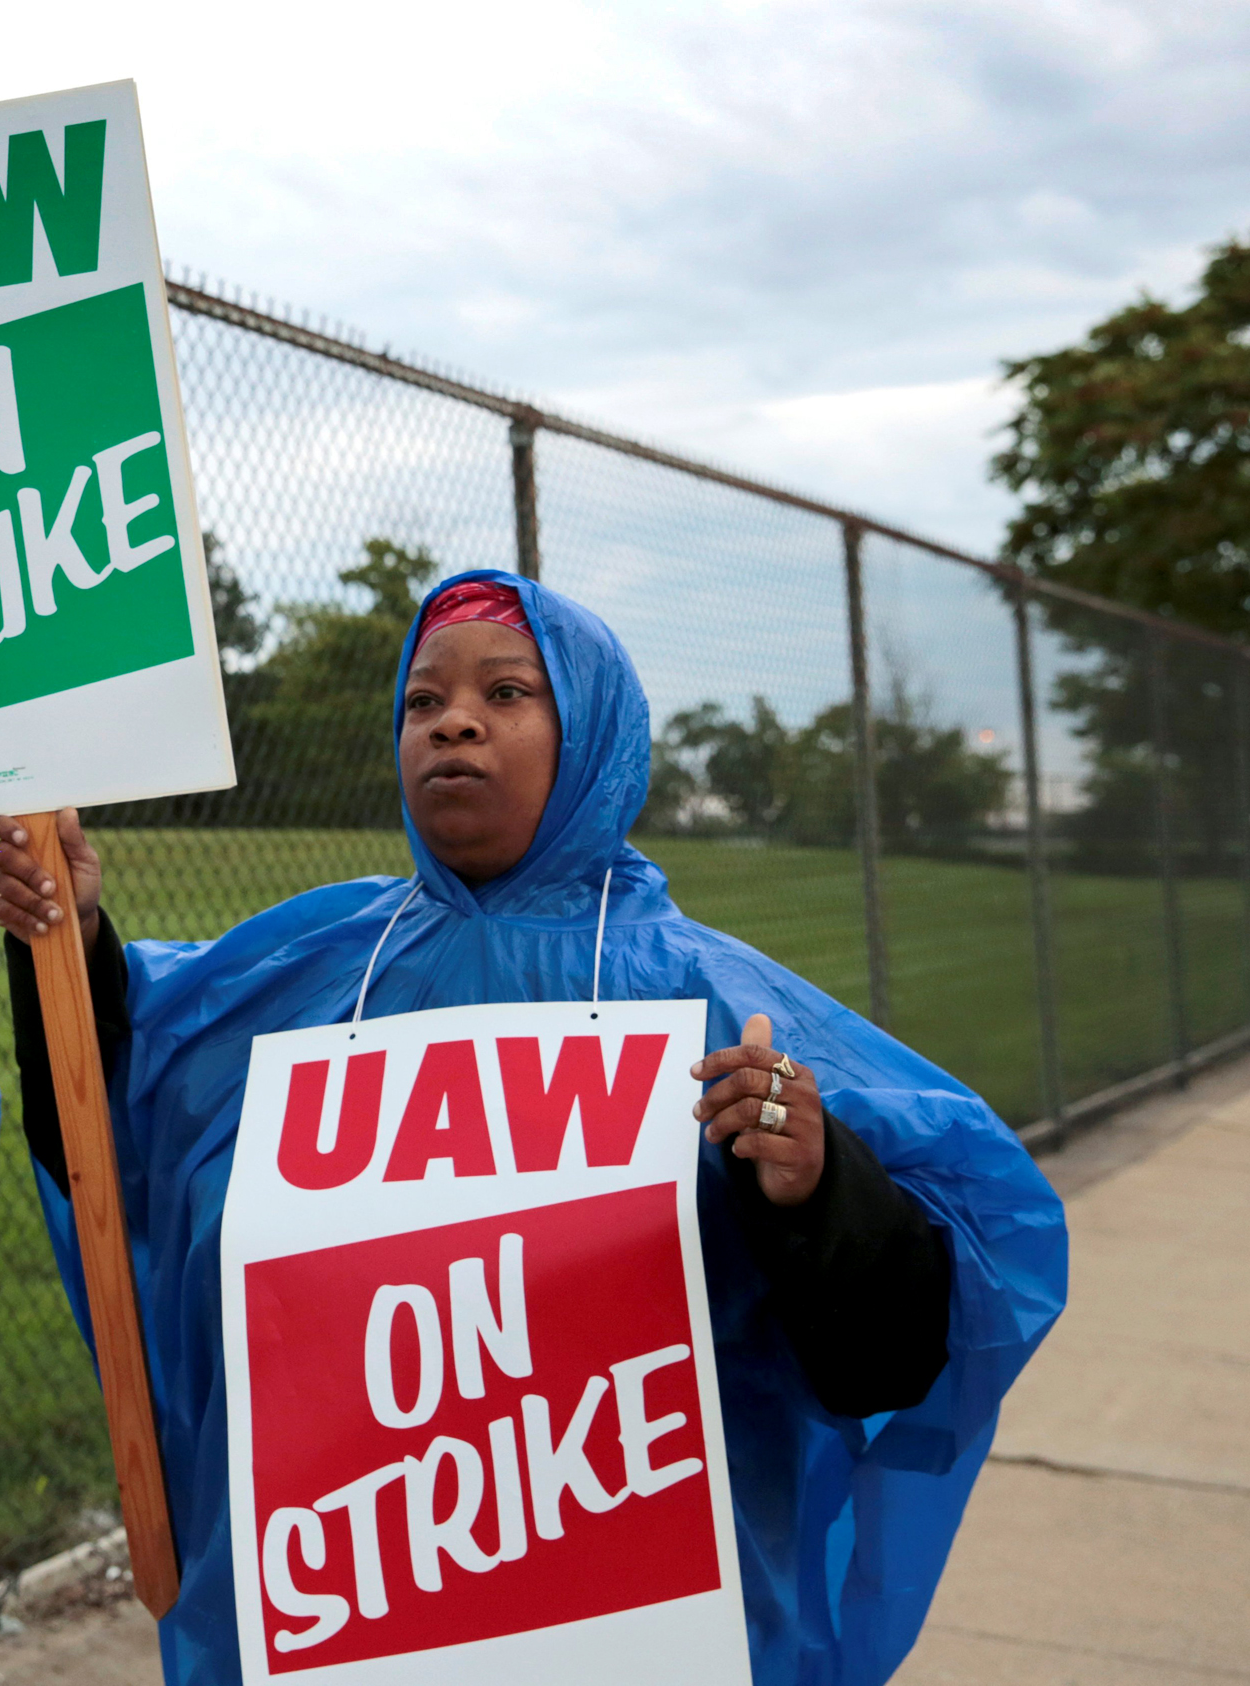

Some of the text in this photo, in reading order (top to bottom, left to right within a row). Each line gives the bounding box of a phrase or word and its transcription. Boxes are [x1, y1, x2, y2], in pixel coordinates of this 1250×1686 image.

[277, 1034, 670, 1190] UAW
[364, 1233, 534, 1429] ON
[262, 1343, 704, 1653] STRIKE
